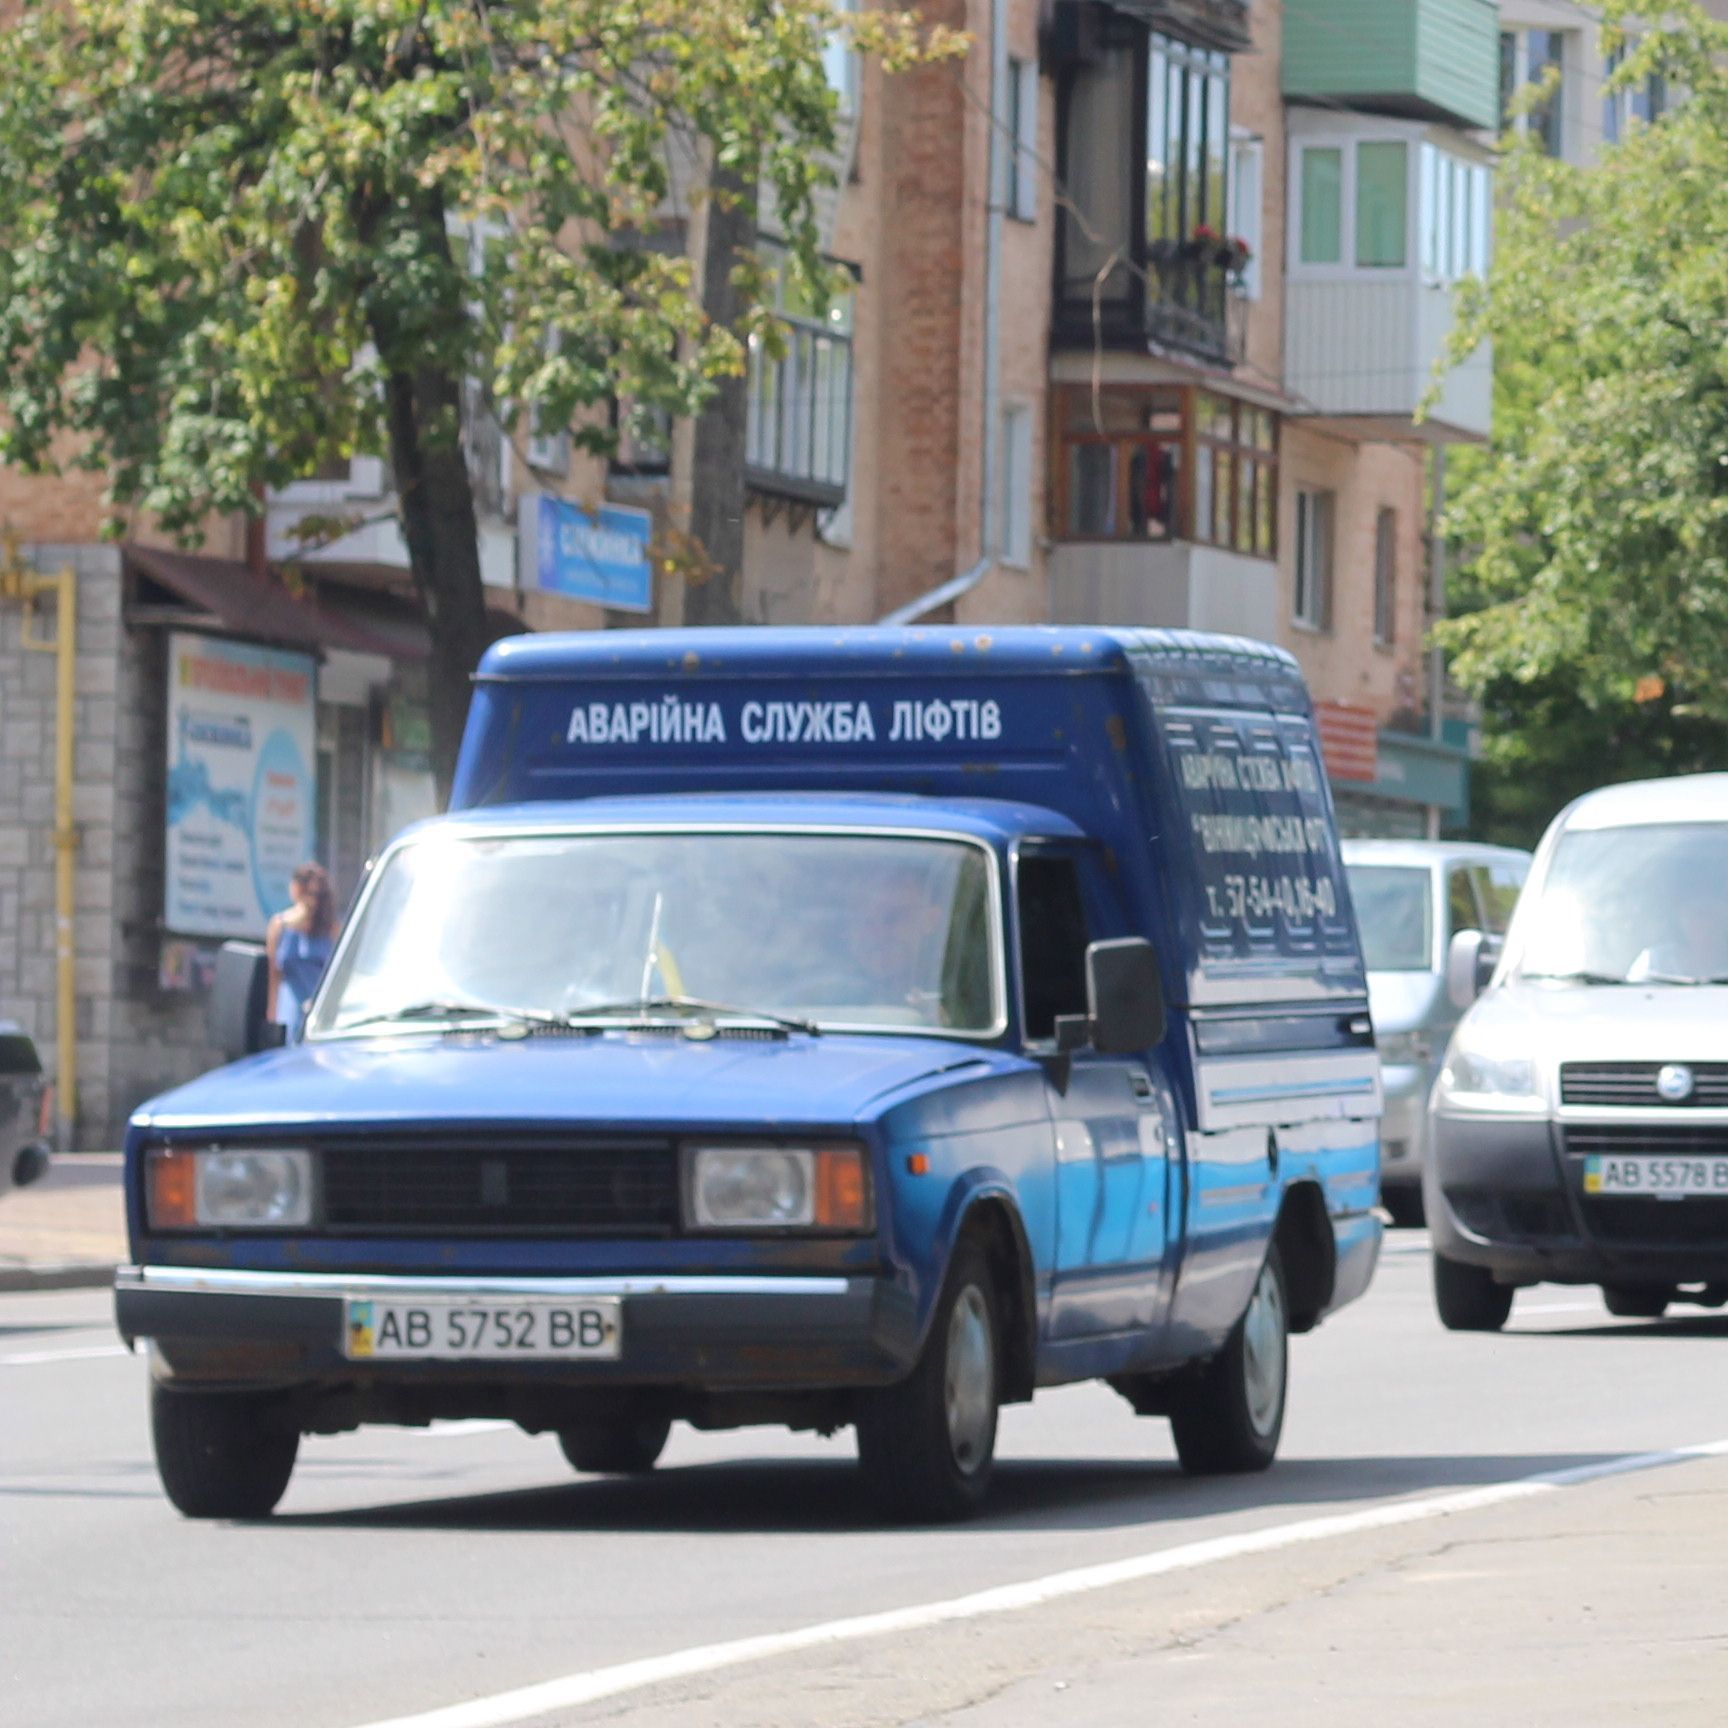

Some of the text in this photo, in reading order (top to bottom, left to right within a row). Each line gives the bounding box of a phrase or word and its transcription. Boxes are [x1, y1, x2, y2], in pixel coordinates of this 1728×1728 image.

[567, 694, 1002, 743] АВАРІЙНА СЛУЖБА ЛІФТІВ
[377, 1309, 433, 1349] AB
[447, 1310, 537, 1349] 5752
